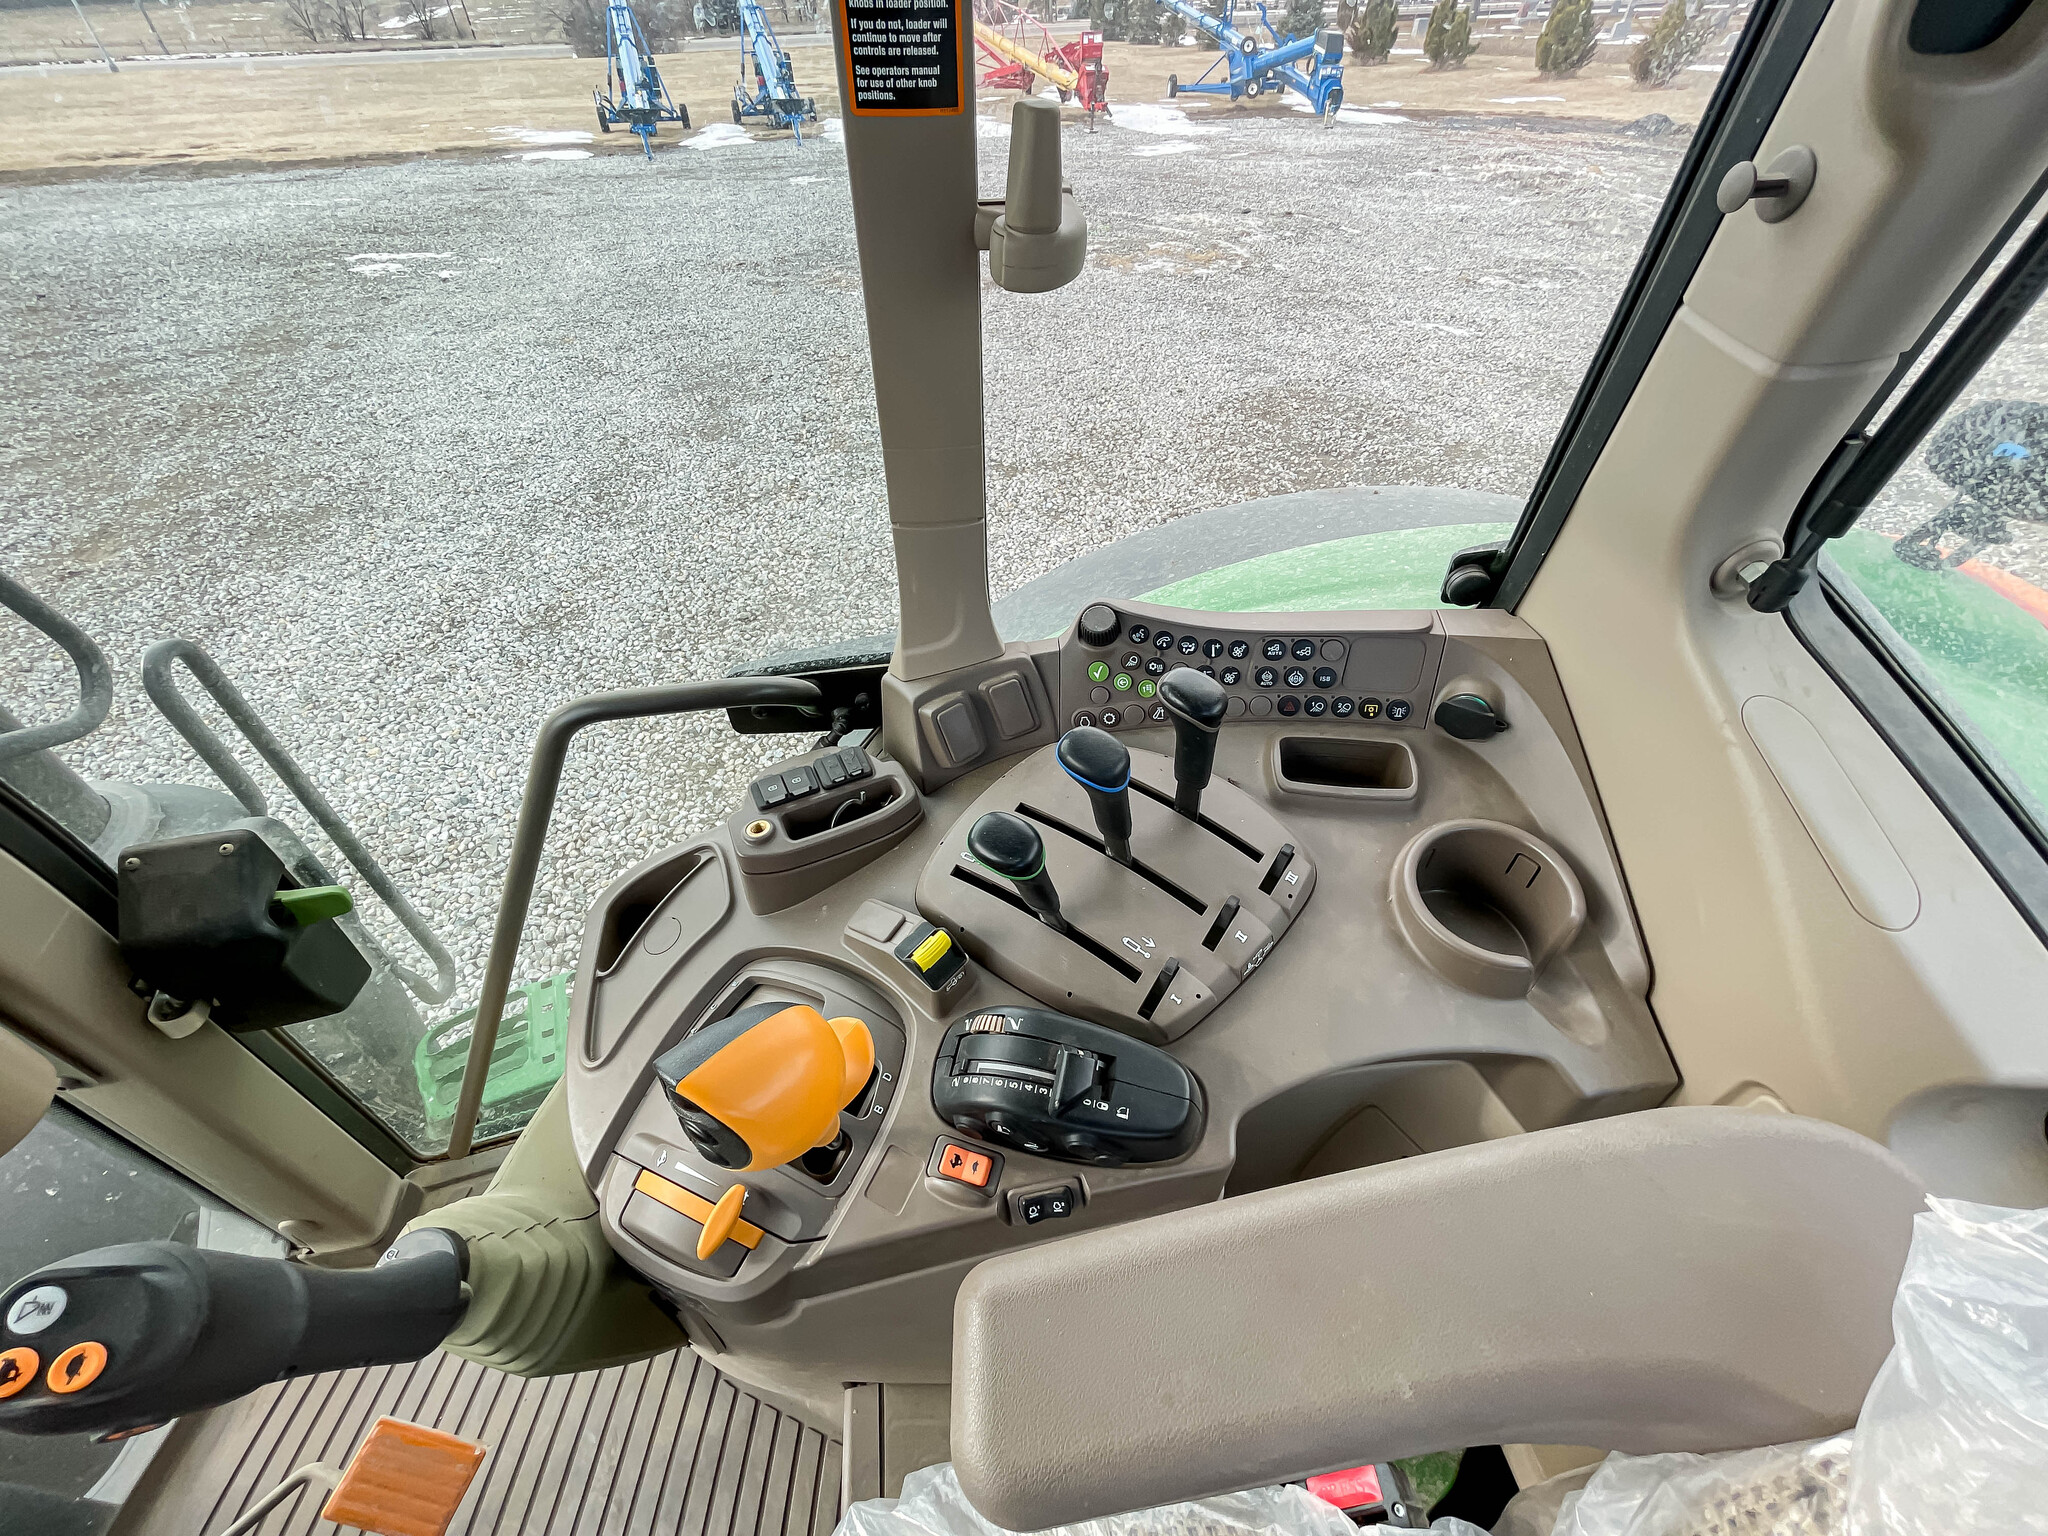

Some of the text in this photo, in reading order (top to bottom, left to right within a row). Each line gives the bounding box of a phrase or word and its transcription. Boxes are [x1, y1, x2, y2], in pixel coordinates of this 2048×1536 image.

[848, 0, 949, 10] knobs in loader position.
[850, 18, 948, 31] If you do not, loader will
[852, 32, 942, 42] continue to move after
[853, 45, 939, 56] controls are released.
[855, 65, 940, 77] See operators manual
[857, 77, 938, 88] for use of other knob
[858, 90, 896, 101] positions.
[882, 1072, 892, 1082] D
[1009, 1081, 1018, 1089] 5
[1024, 1083, 1033, 1092] 4
[1039, 1087, 1048, 1095] 3
[873, 1104, 884, 1115] B
